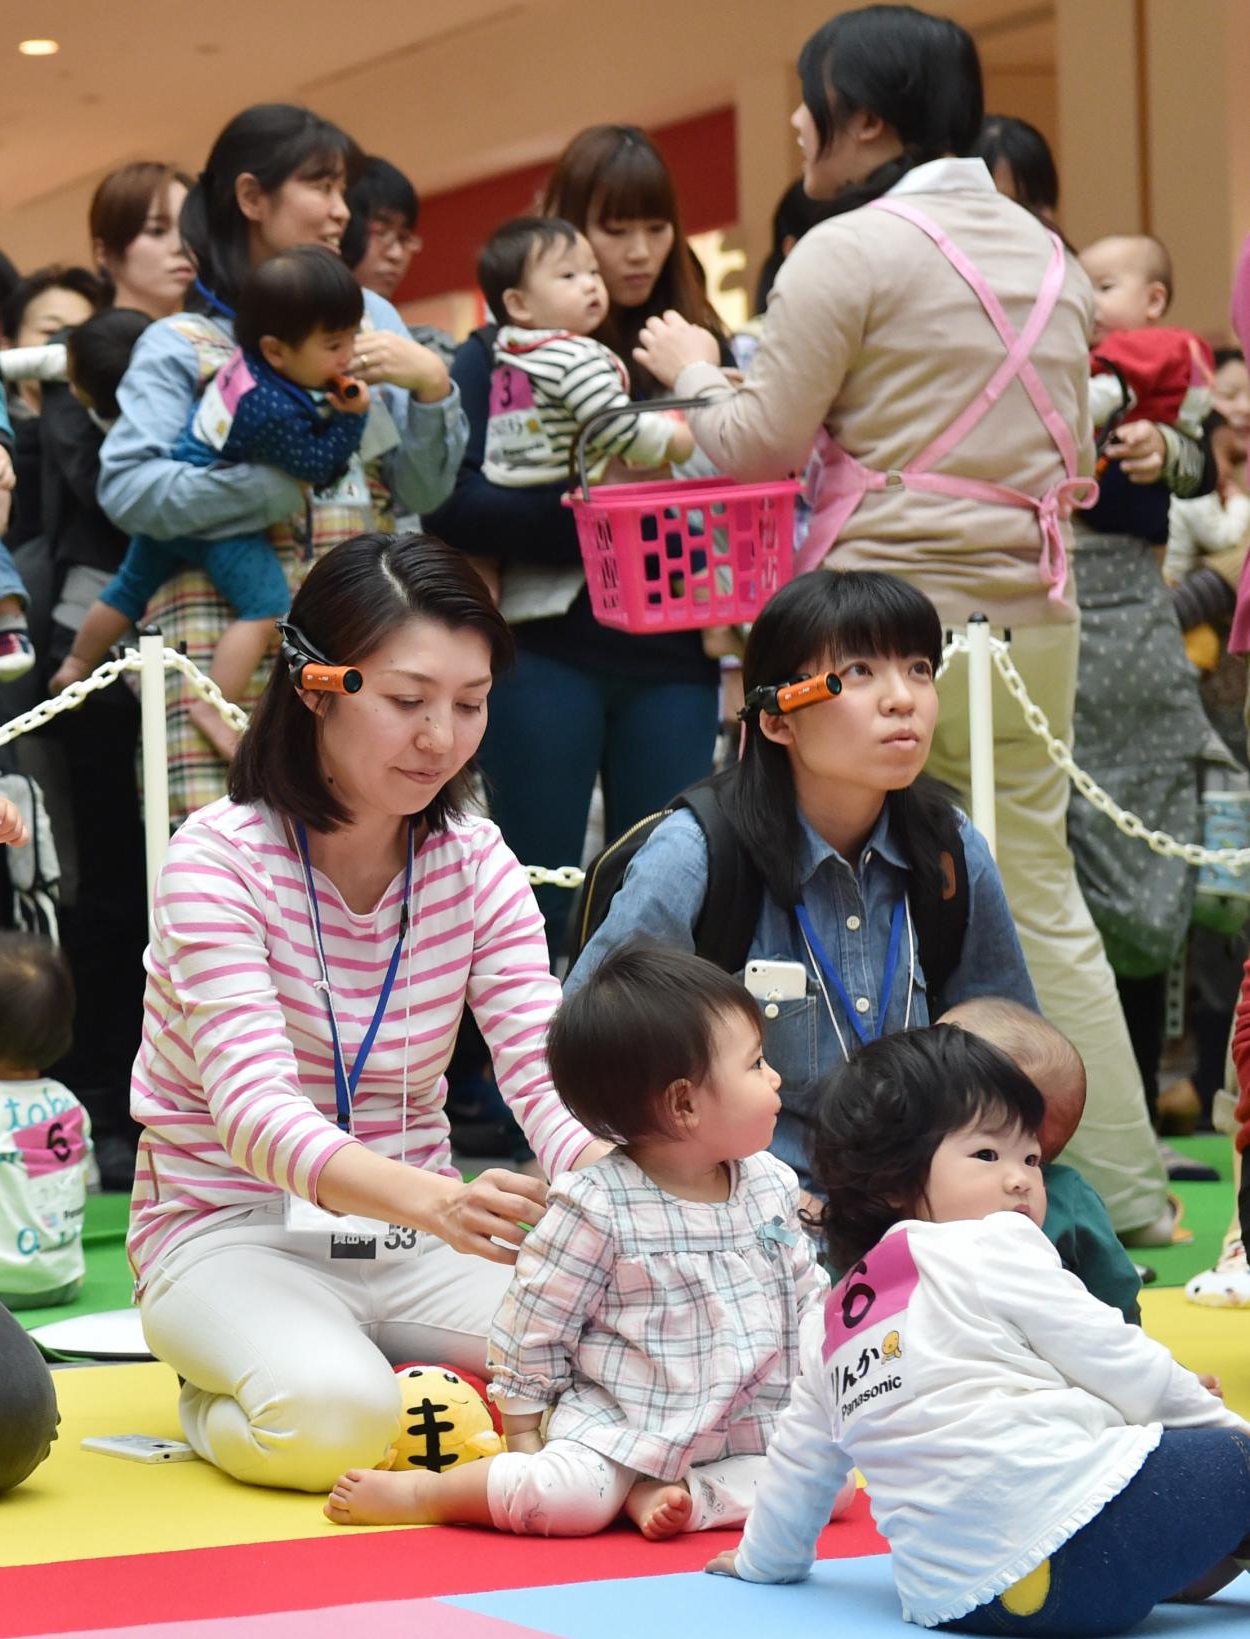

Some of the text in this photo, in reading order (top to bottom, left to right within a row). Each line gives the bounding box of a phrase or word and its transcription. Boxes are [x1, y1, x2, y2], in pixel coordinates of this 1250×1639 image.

[501, 370, 512, 408] 3
[46, 1122, 71, 1163] 6
[384, 1224, 417, 1250] 53
[841, 1259, 877, 1329] 6
[830, 1347, 880, 1406] りんか
[841, 1374, 903, 1421] Panasonic
